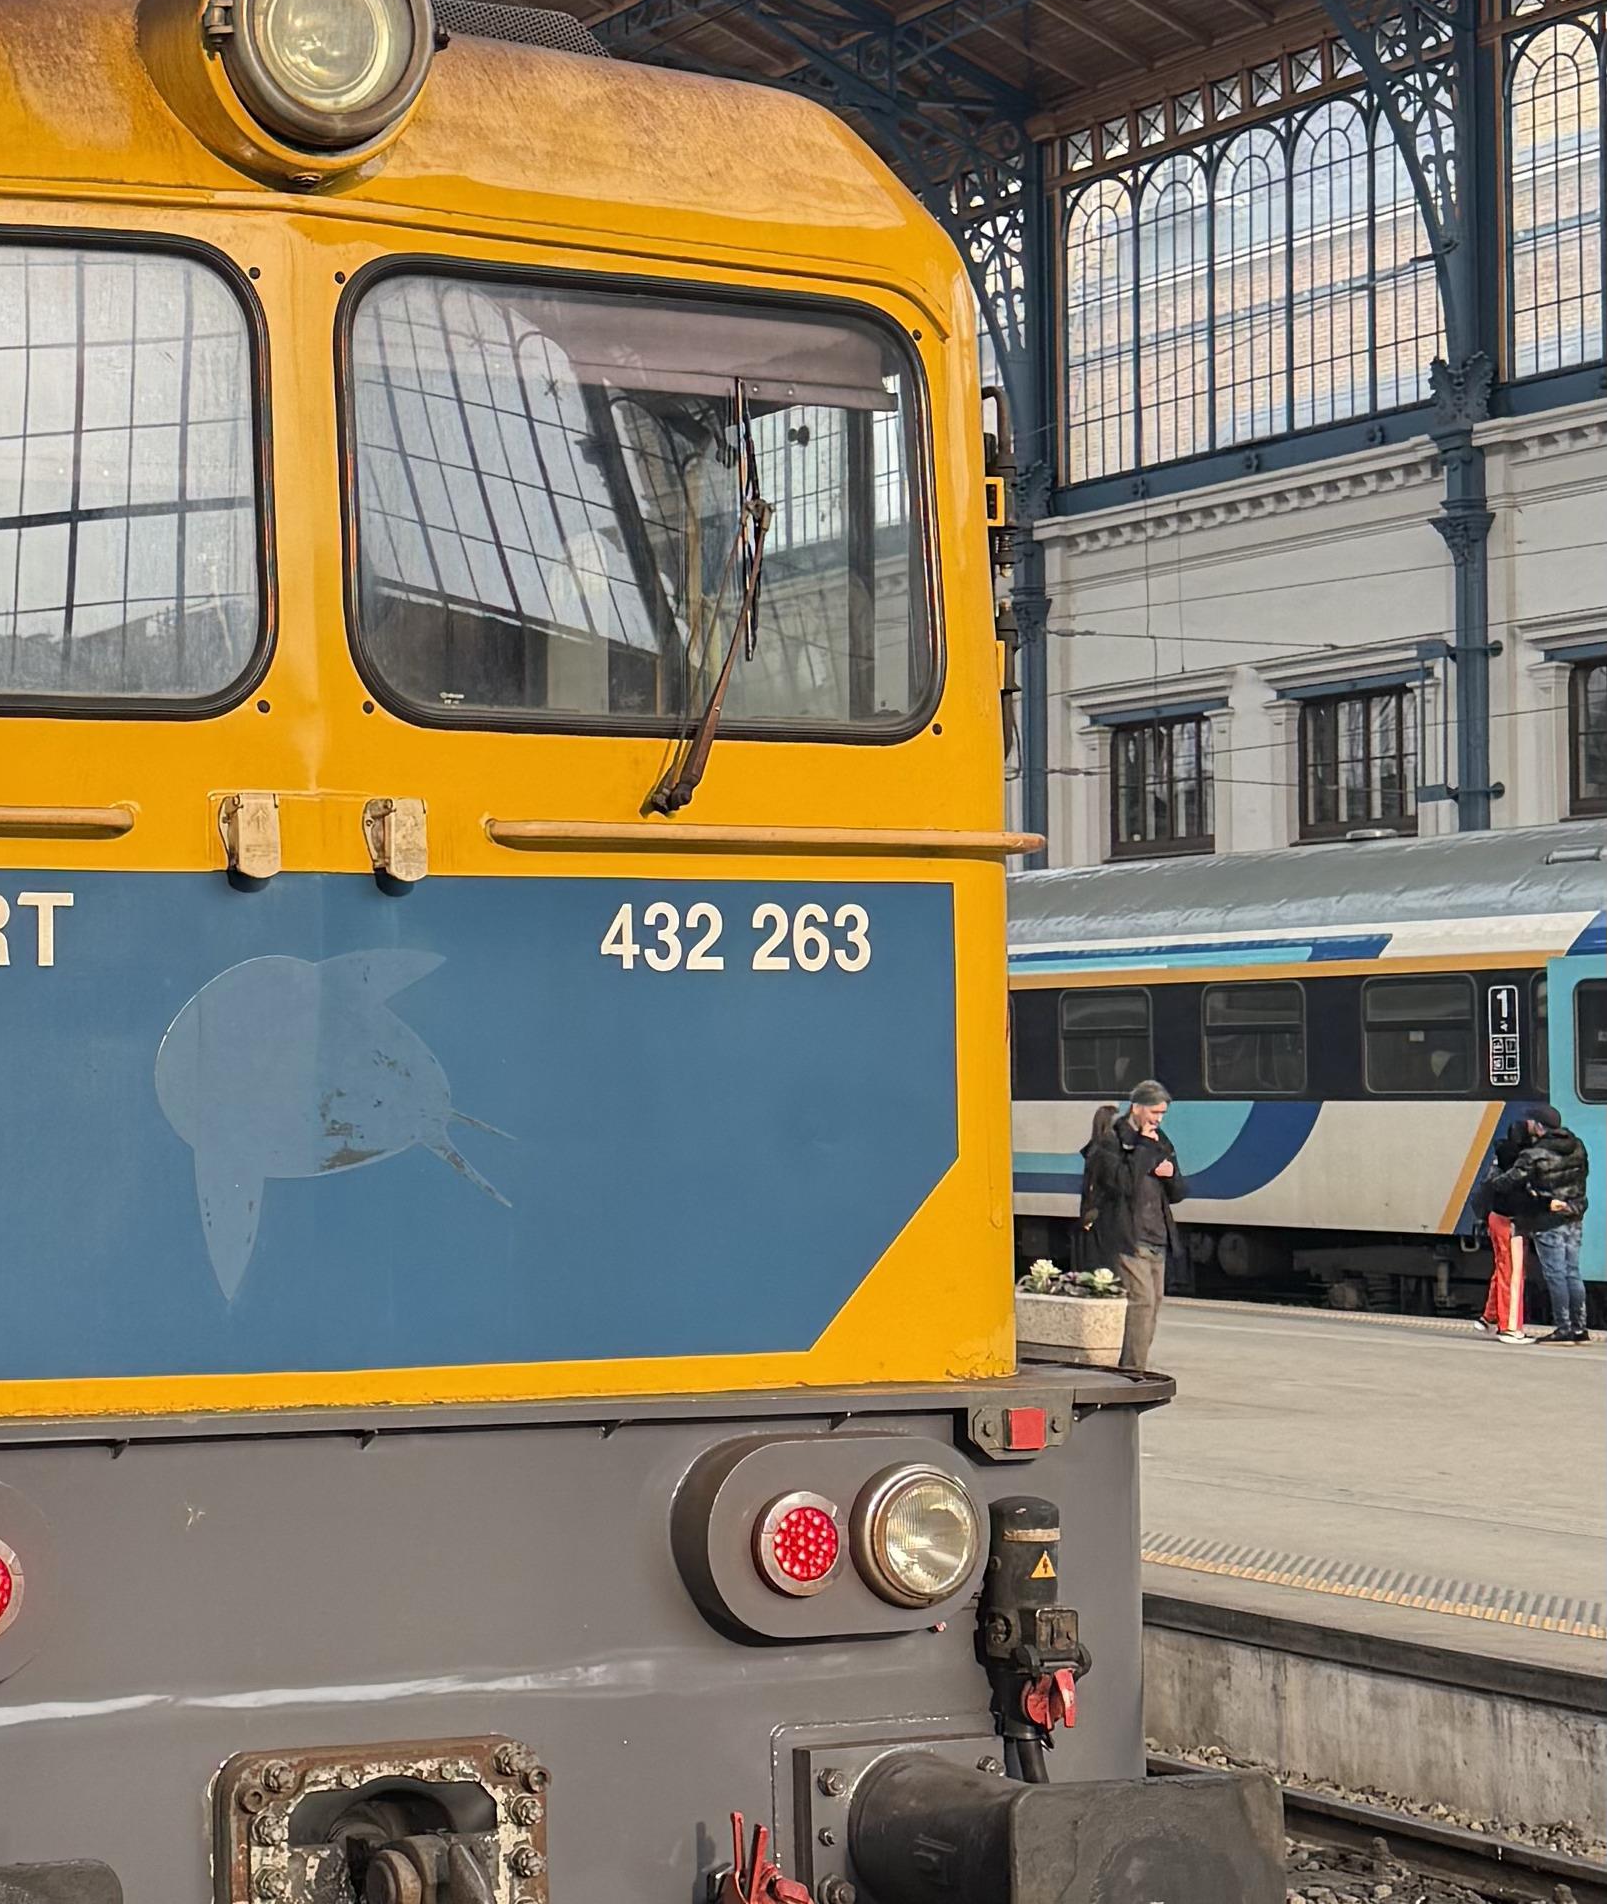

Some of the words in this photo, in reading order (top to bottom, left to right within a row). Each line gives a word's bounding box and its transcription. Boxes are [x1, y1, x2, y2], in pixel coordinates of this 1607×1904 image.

[600, 901, 725, 972] 432
[751, 902, 872, 973] 263
[1496, 989, 1509, 1018] 1
